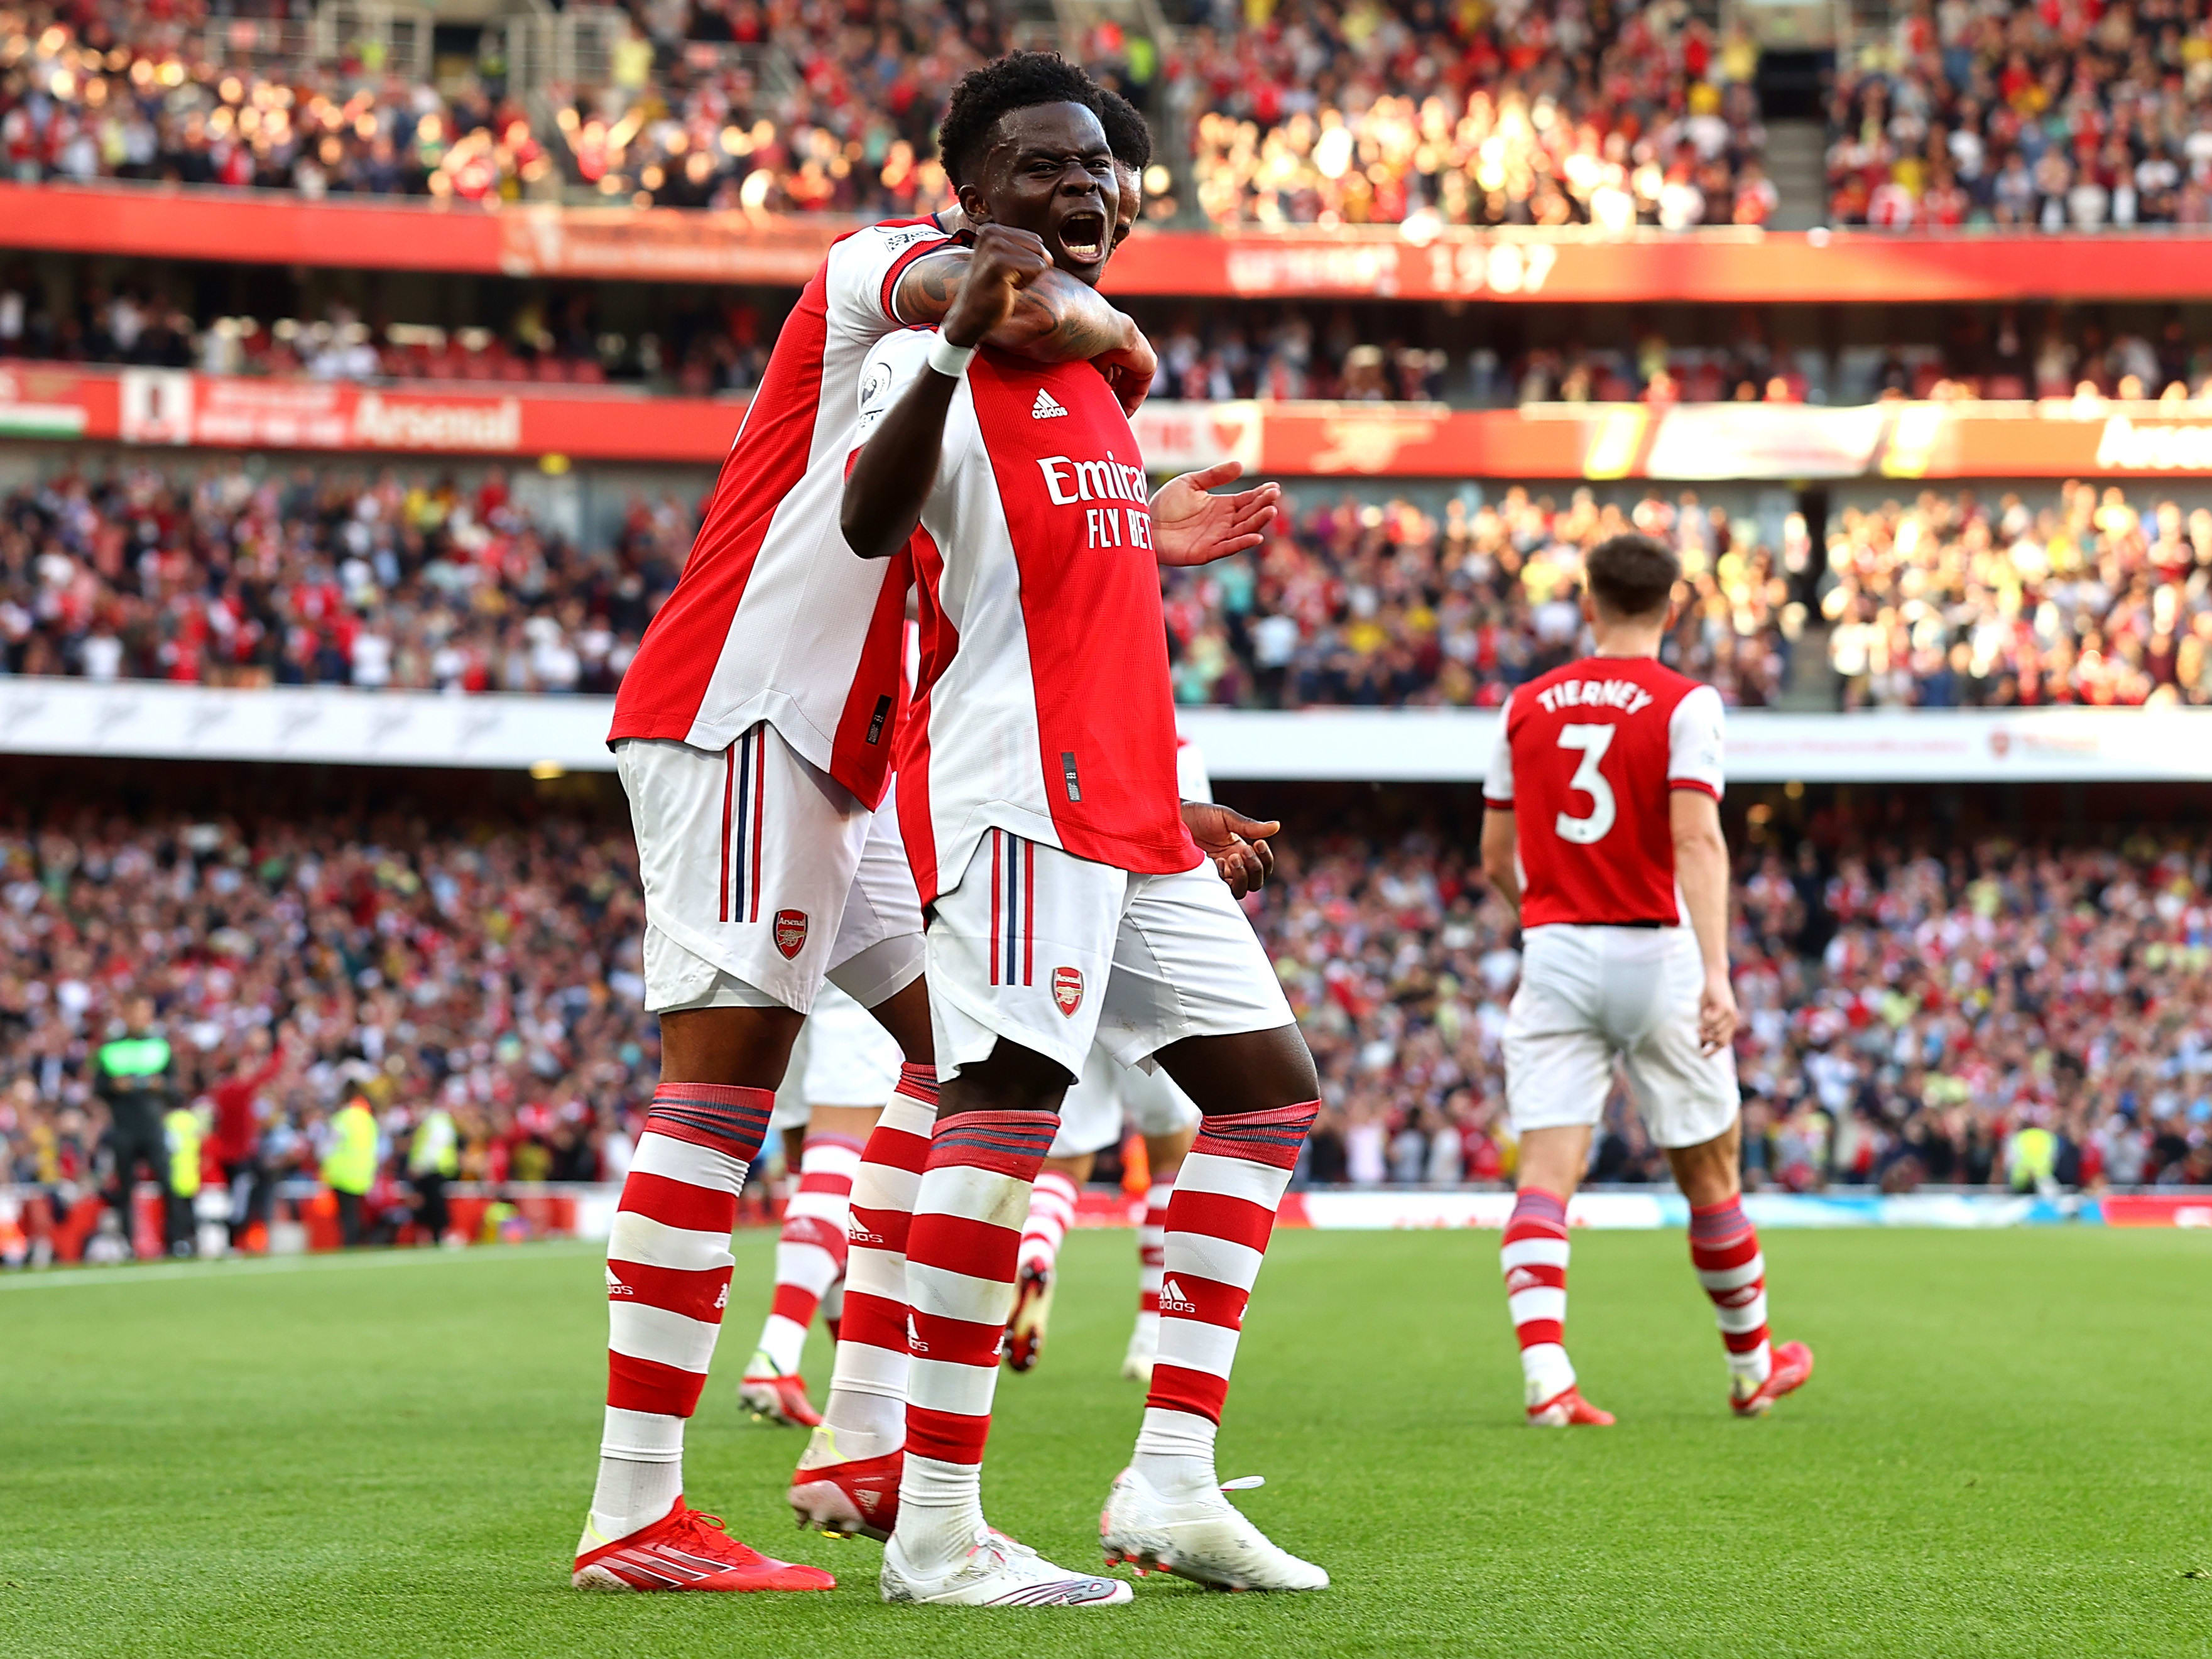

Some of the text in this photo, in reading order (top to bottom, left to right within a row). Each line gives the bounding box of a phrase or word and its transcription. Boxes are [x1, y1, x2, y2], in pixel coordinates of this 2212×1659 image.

[1032, 406, 1068, 420] adidas
[1036, 450, 1148, 506] Emirat
[1086, 508, 1121, 549] FLY
[1535, 678, 1654, 715] TIERNEY
[1555, 722, 1618, 845] 3
[778, 917, 805, 927] Arsenal
